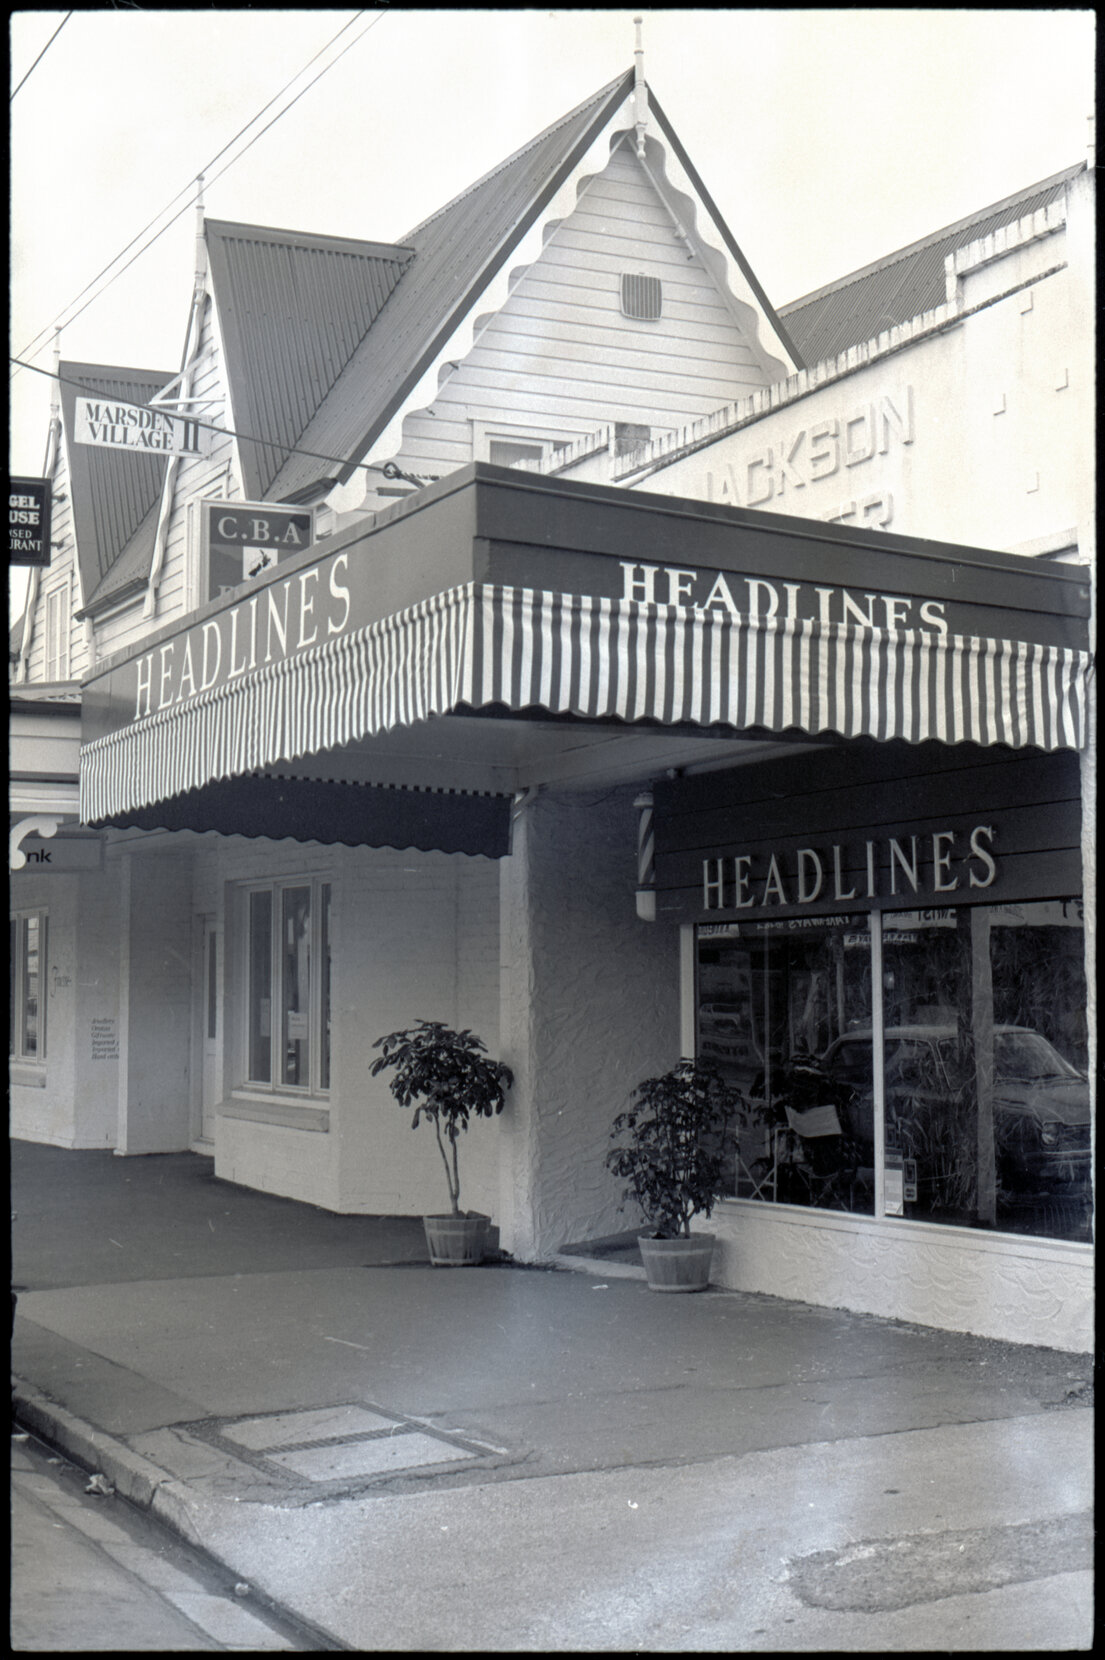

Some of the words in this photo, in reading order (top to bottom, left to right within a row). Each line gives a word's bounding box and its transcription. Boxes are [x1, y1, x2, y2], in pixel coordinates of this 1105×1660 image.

[85, 402, 175, 432] MARSDEN
[88, 422, 174, 451] VILLAGE
[179, 416, 202, 454] II
[619, 561, 948, 635] HEADLINES
[134, 553, 350, 721] HEADLINES
[702, 825, 998, 910] HEADLINES
